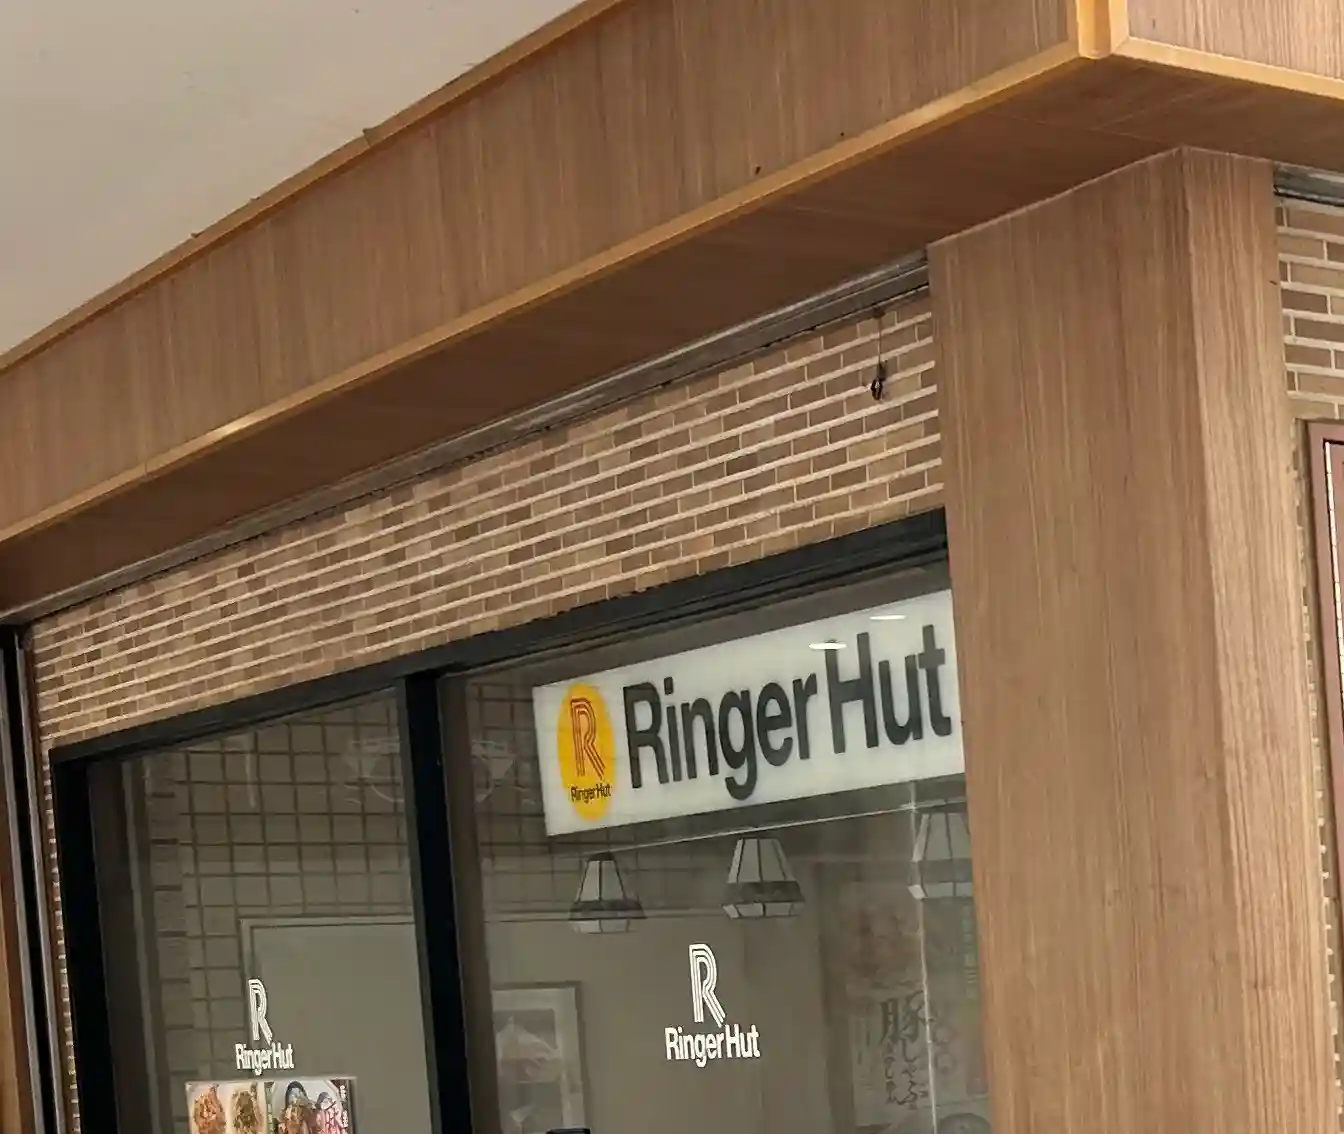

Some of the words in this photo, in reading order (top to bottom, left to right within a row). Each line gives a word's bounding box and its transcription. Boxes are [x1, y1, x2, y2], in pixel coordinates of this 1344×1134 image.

[570, 698, 606, 780] R
[623, 673, 818, 800] Ringer
[825, 624, 952, 755] Hut
[248, 978, 273, 1044] R
[688, 943, 727, 1029] R
[235, 1043, 273, 1076] Ringer
[272, 1041, 295, 1070] Hut
[664, 1026, 725, 1068] Ringer
[725, 1023, 761, 1059] Hut
